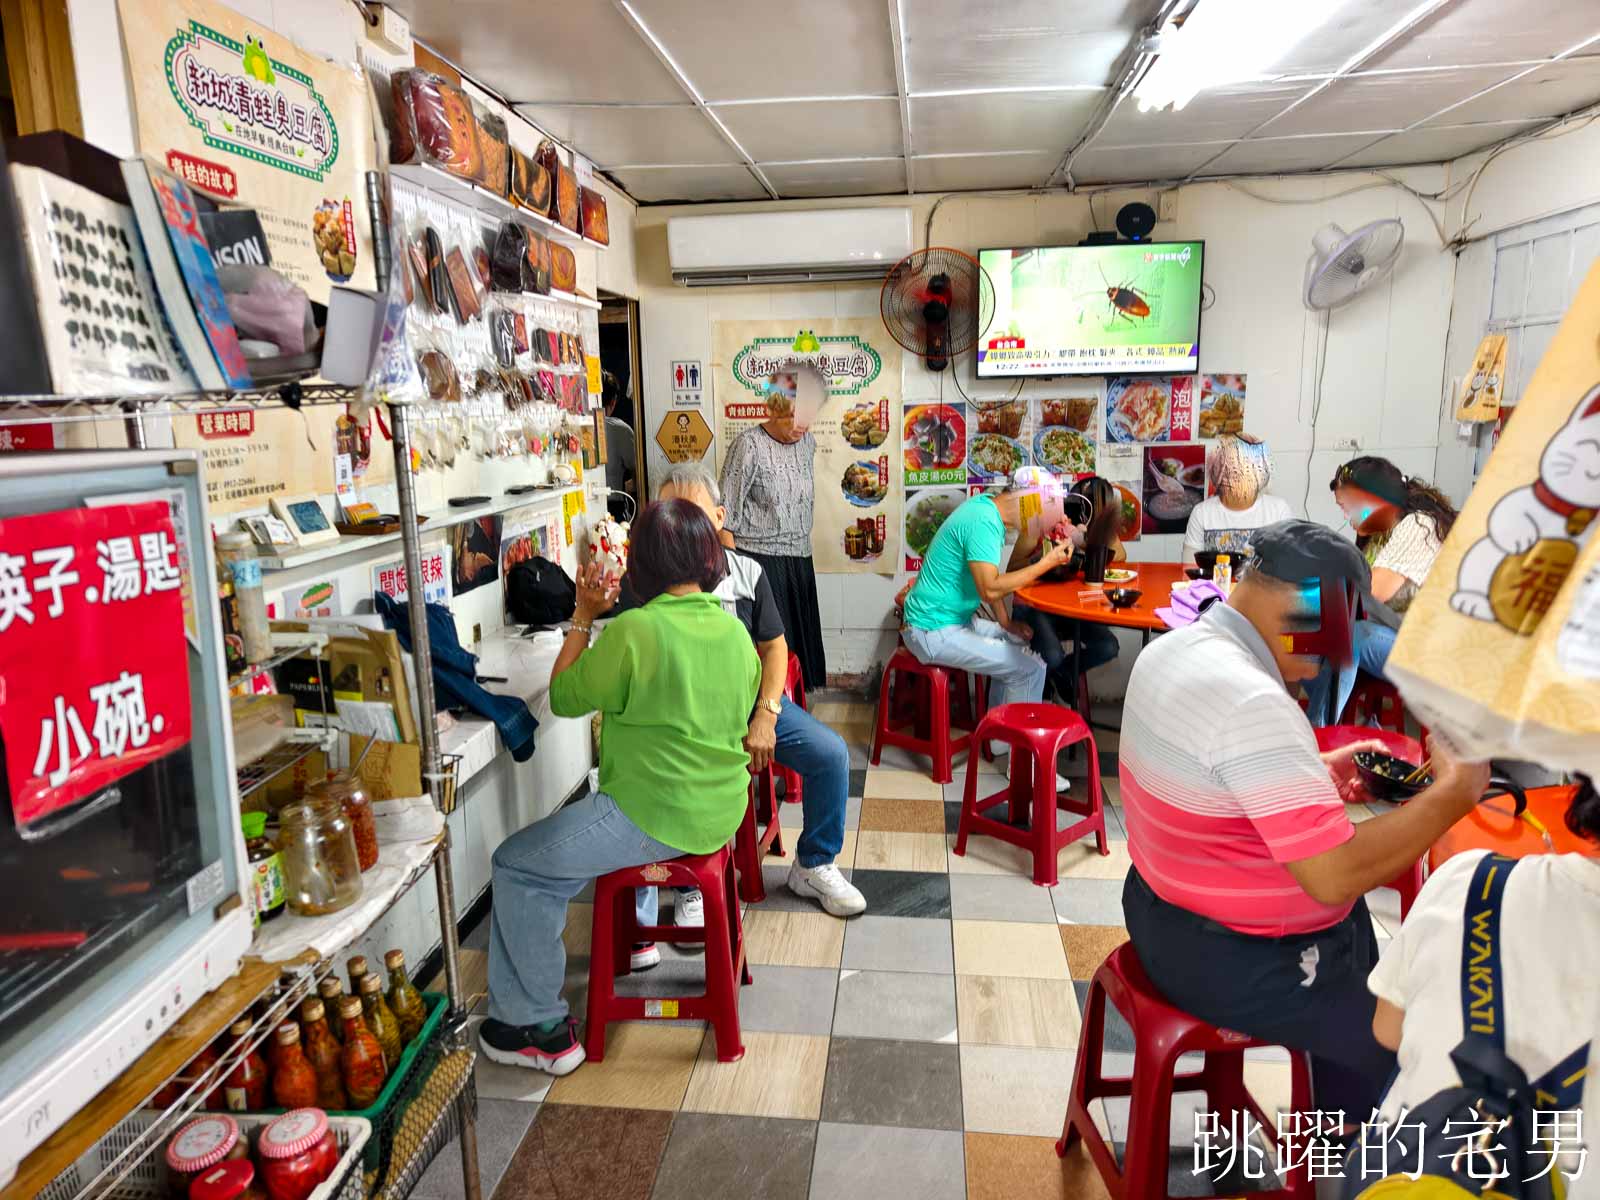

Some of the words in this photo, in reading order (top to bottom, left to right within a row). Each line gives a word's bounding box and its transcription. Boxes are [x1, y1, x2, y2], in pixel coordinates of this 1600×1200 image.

[187, 56, 326, 153] 新城青蛙臭豆腐
[171, 155, 234, 194] 青蛙的故事
[201, 412, 251, 435] 營業時間
[728, 405, 769, 417] 青蛙的故
[1173, 389, 1193, 431] 泡菜
[908, 471, 965, 484] 魚皮湯60元
[1509, 556, 1572, 615] 福
[1468, 909, 1495, 1034] WAKATI
